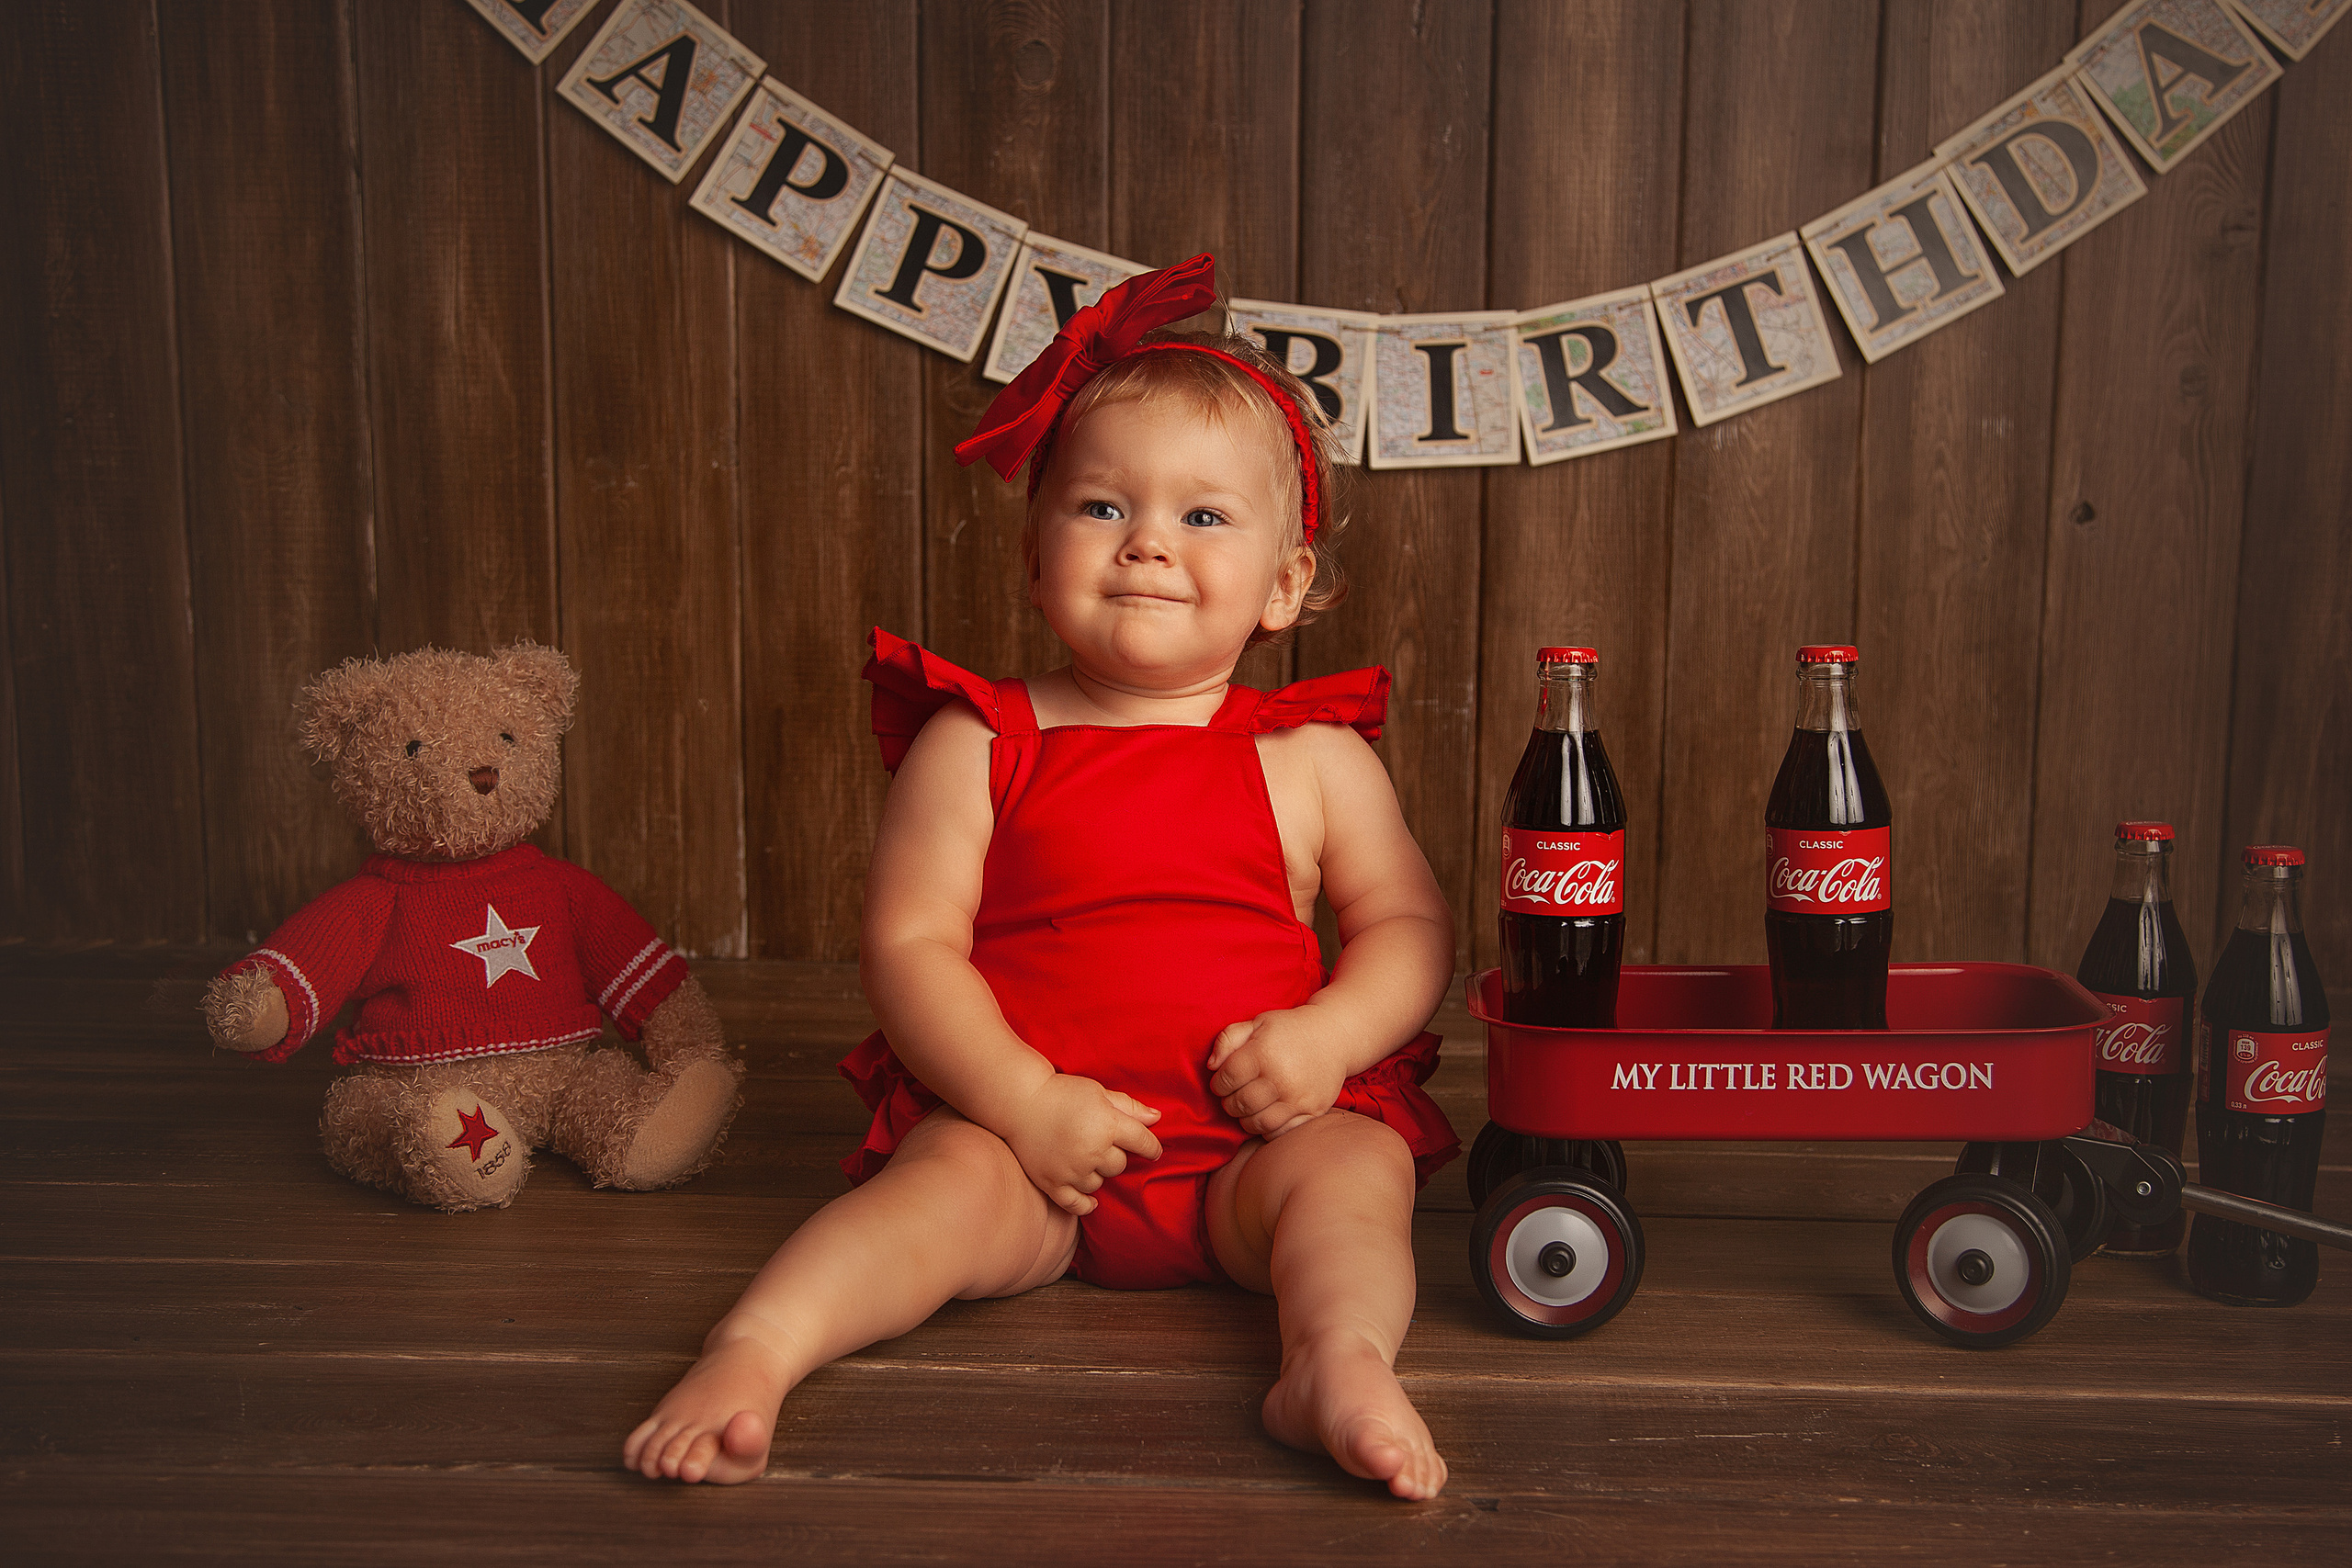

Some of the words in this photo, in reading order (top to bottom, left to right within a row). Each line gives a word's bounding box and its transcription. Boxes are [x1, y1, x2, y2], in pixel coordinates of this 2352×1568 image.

[502, 0, 1090, 330] APP
[1252, 0, 2322, 443] BIRTHDA
[1536, 840, 1581, 851] CLASSIC
[1799, 840, 1844, 850] CLASSIC
[1504, 857, 1620, 906] Coca-Cola
[1770, 856, 1885, 904] Coca-Cola
[2291, 1039, 2324, 1051] CLASSIC
[1611, 1063, 1664, 1090] MY
[1668, 1063, 1775, 1090] LITTLE
[1786, 1063, 1852, 1090] RED
[1860, 1063, 1993, 1090] WAGON
[2244, 1054, 2328, 1103] Coca-Co
[474, 1141, 512, 1179] 1858
